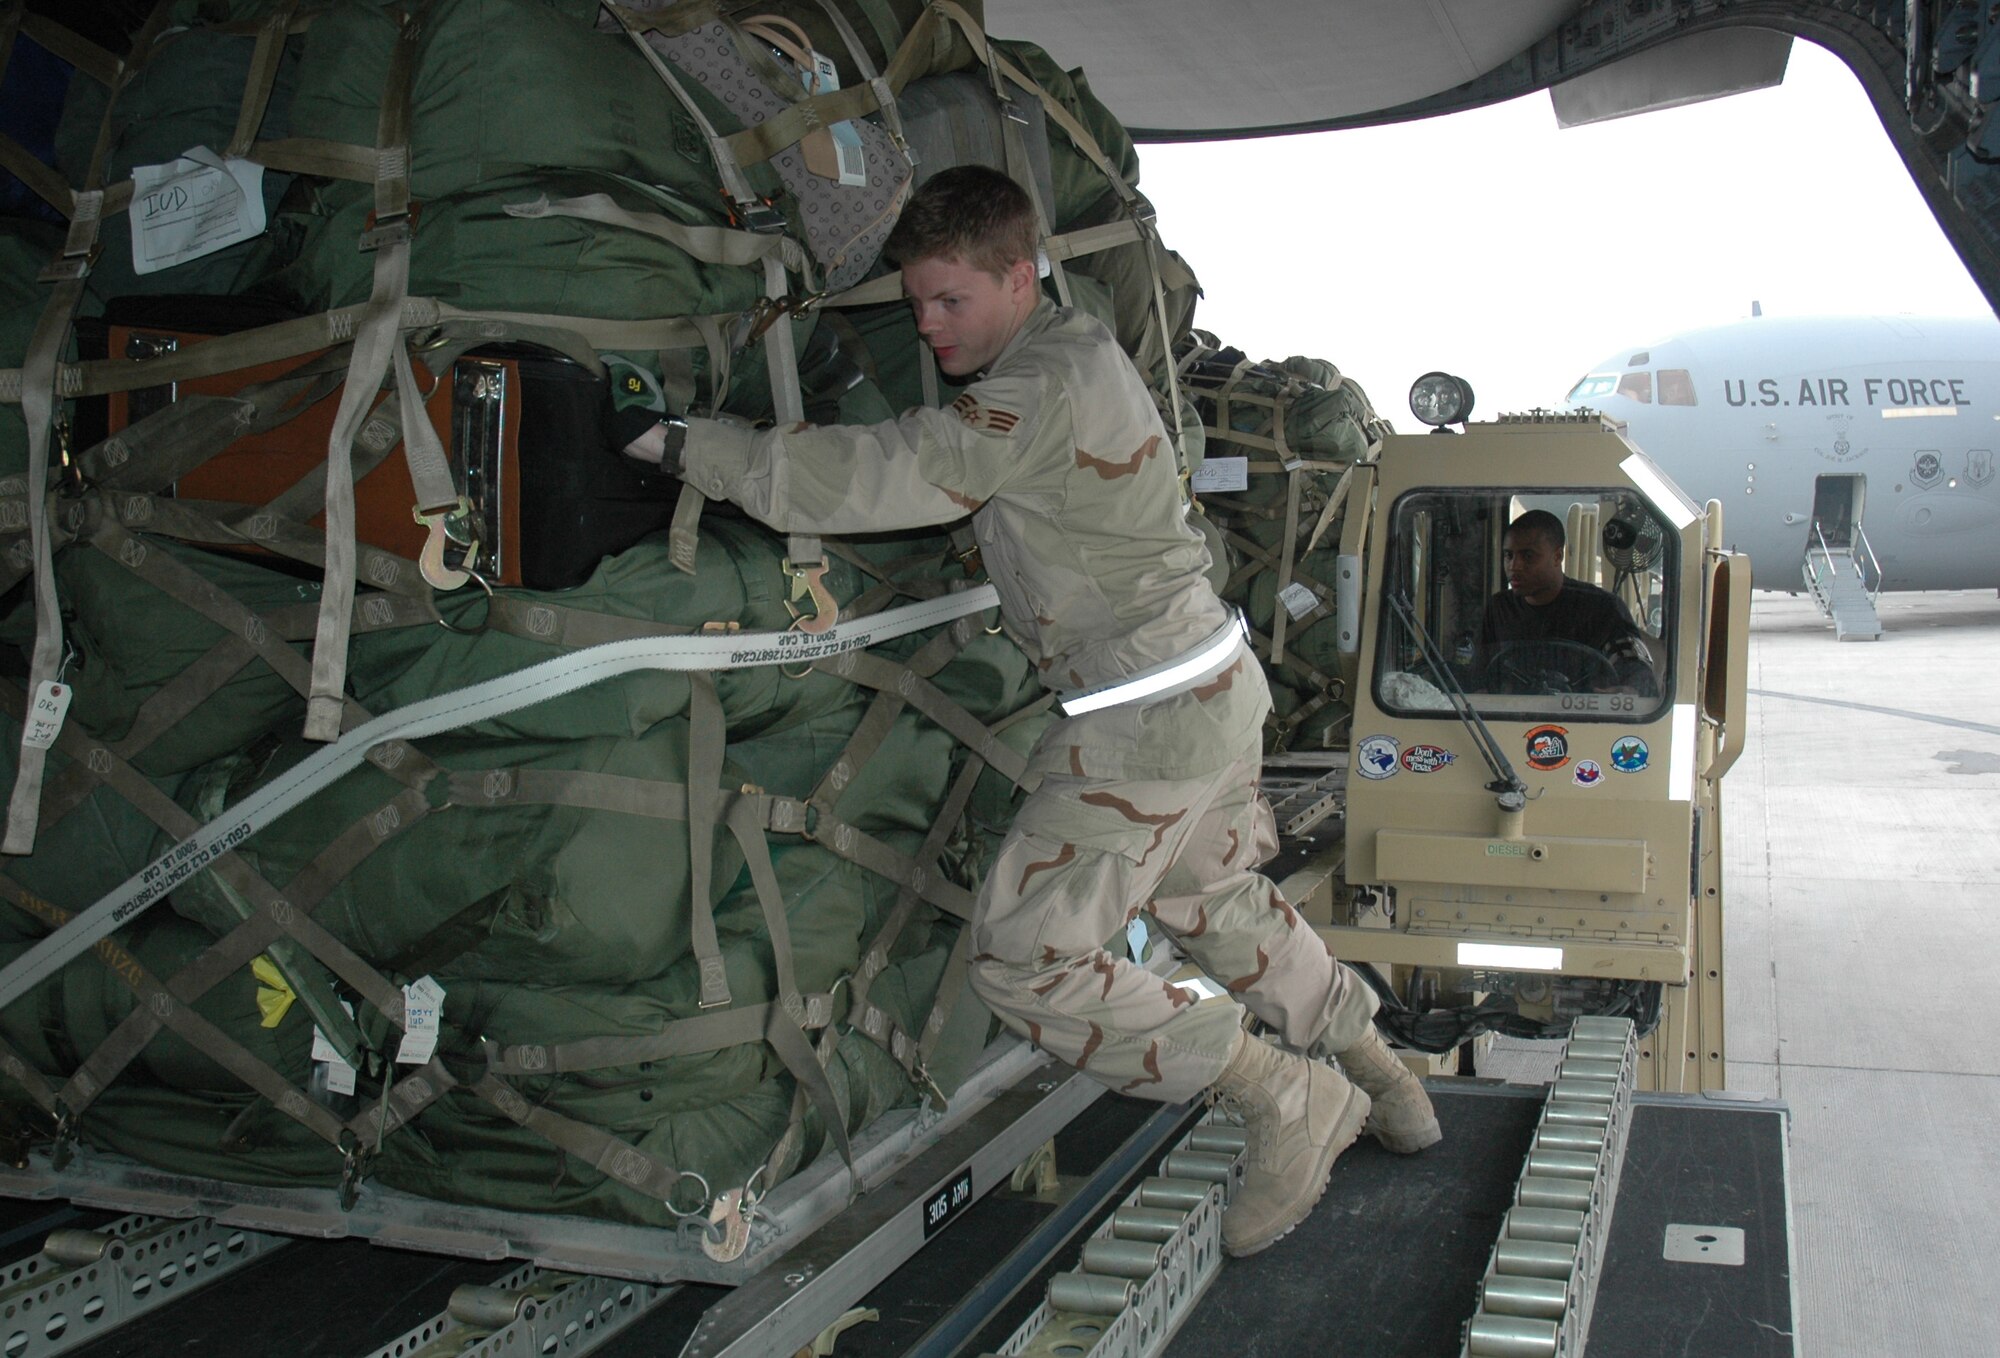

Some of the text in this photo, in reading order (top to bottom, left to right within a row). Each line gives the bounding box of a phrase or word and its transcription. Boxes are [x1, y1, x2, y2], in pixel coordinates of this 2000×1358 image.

[142, 185, 189, 218] IUD
[1724, 378, 1971, 407] U.S. AIR FORCE
[778, 635, 798, 646] CAP.
[1561, 694, 1634, 712] 03E 98
[1405, 755, 1438, 766] mess with
[1411, 762, 1432, 772] Texas
[176, 839, 198, 859] 5000
[1487, 844, 1526, 856] DIESEL
[190, 850, 210, 868] CL2
[140, 865, 161, 884] CAP.
[929, 1193, 948, 1225] 305
